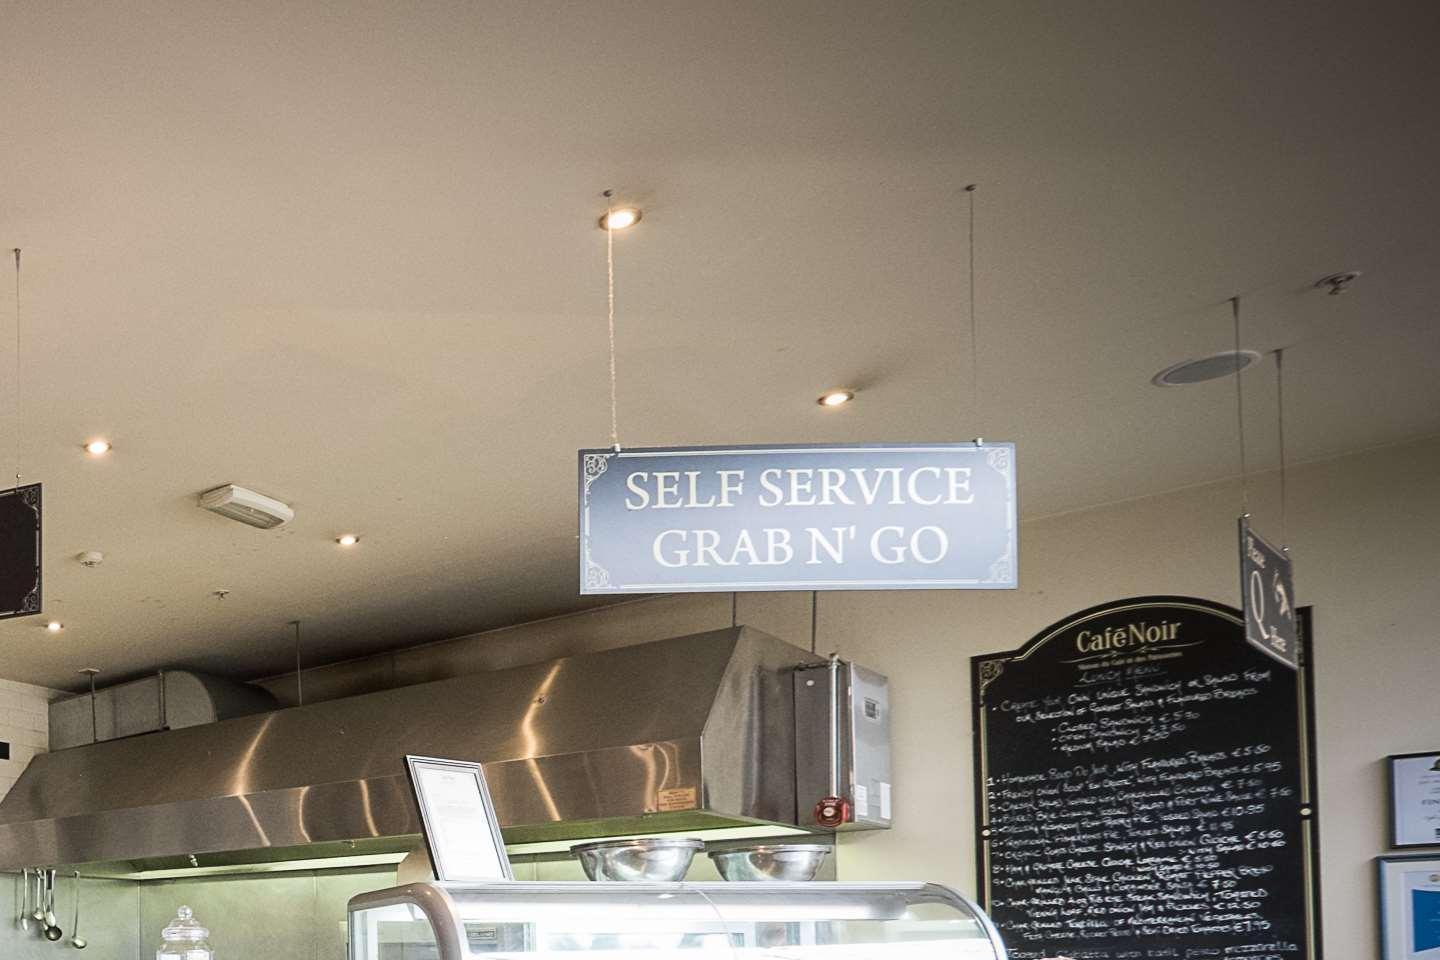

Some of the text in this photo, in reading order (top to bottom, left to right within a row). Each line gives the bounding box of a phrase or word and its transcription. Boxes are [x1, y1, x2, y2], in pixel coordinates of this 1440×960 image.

[624, 467, 975, 511] SELF SERVICE
[652, 525, 949, 568] GRAB N' GO
